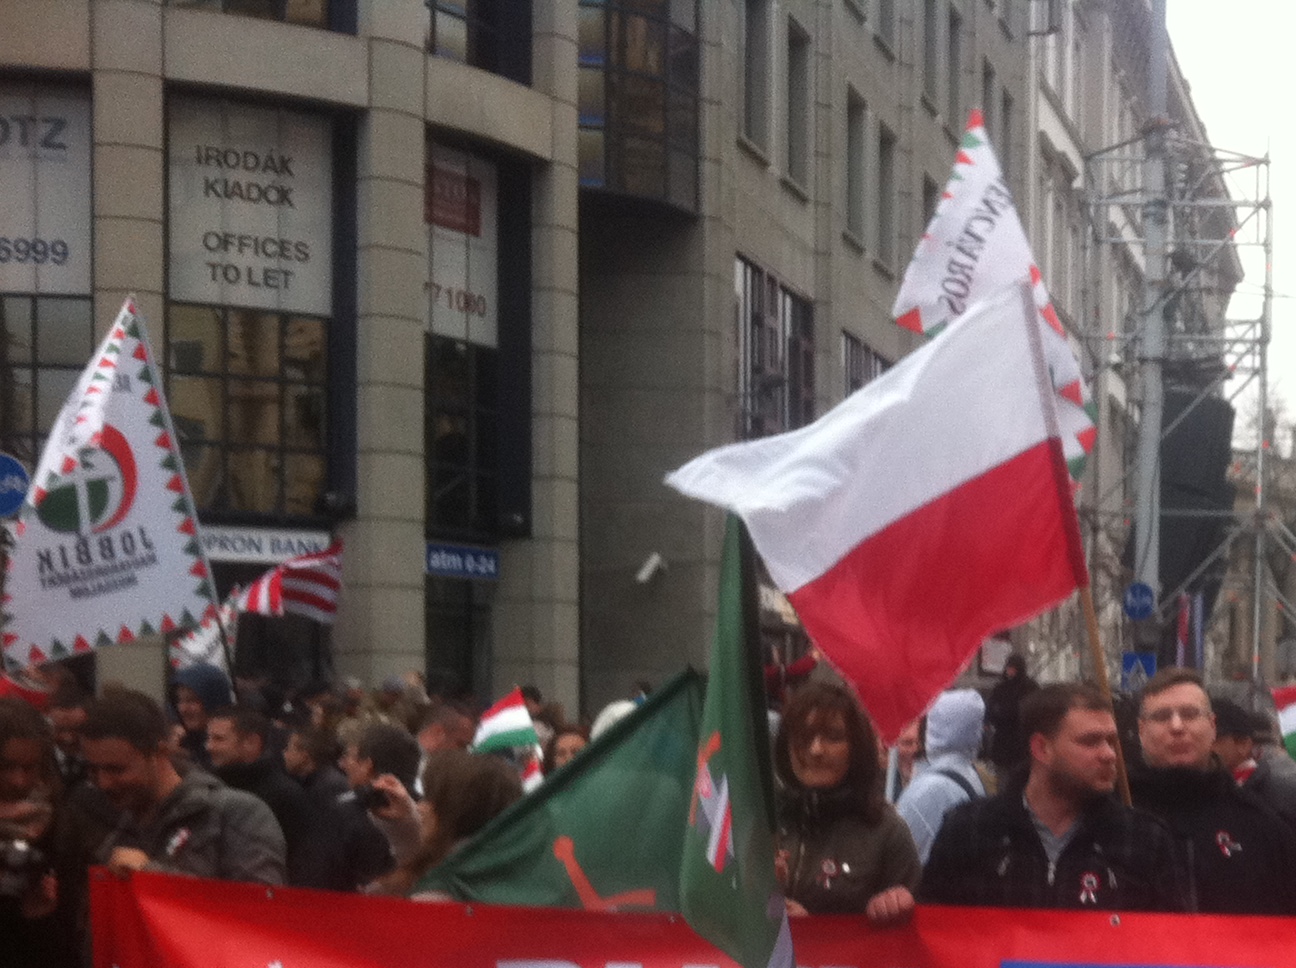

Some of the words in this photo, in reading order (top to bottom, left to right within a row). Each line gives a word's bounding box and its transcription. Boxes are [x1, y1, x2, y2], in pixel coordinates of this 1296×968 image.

[202, 231, 311, 264] OFFICES
[206, 262, 241, 285] TO
[246, 266, 295, 290] LET
